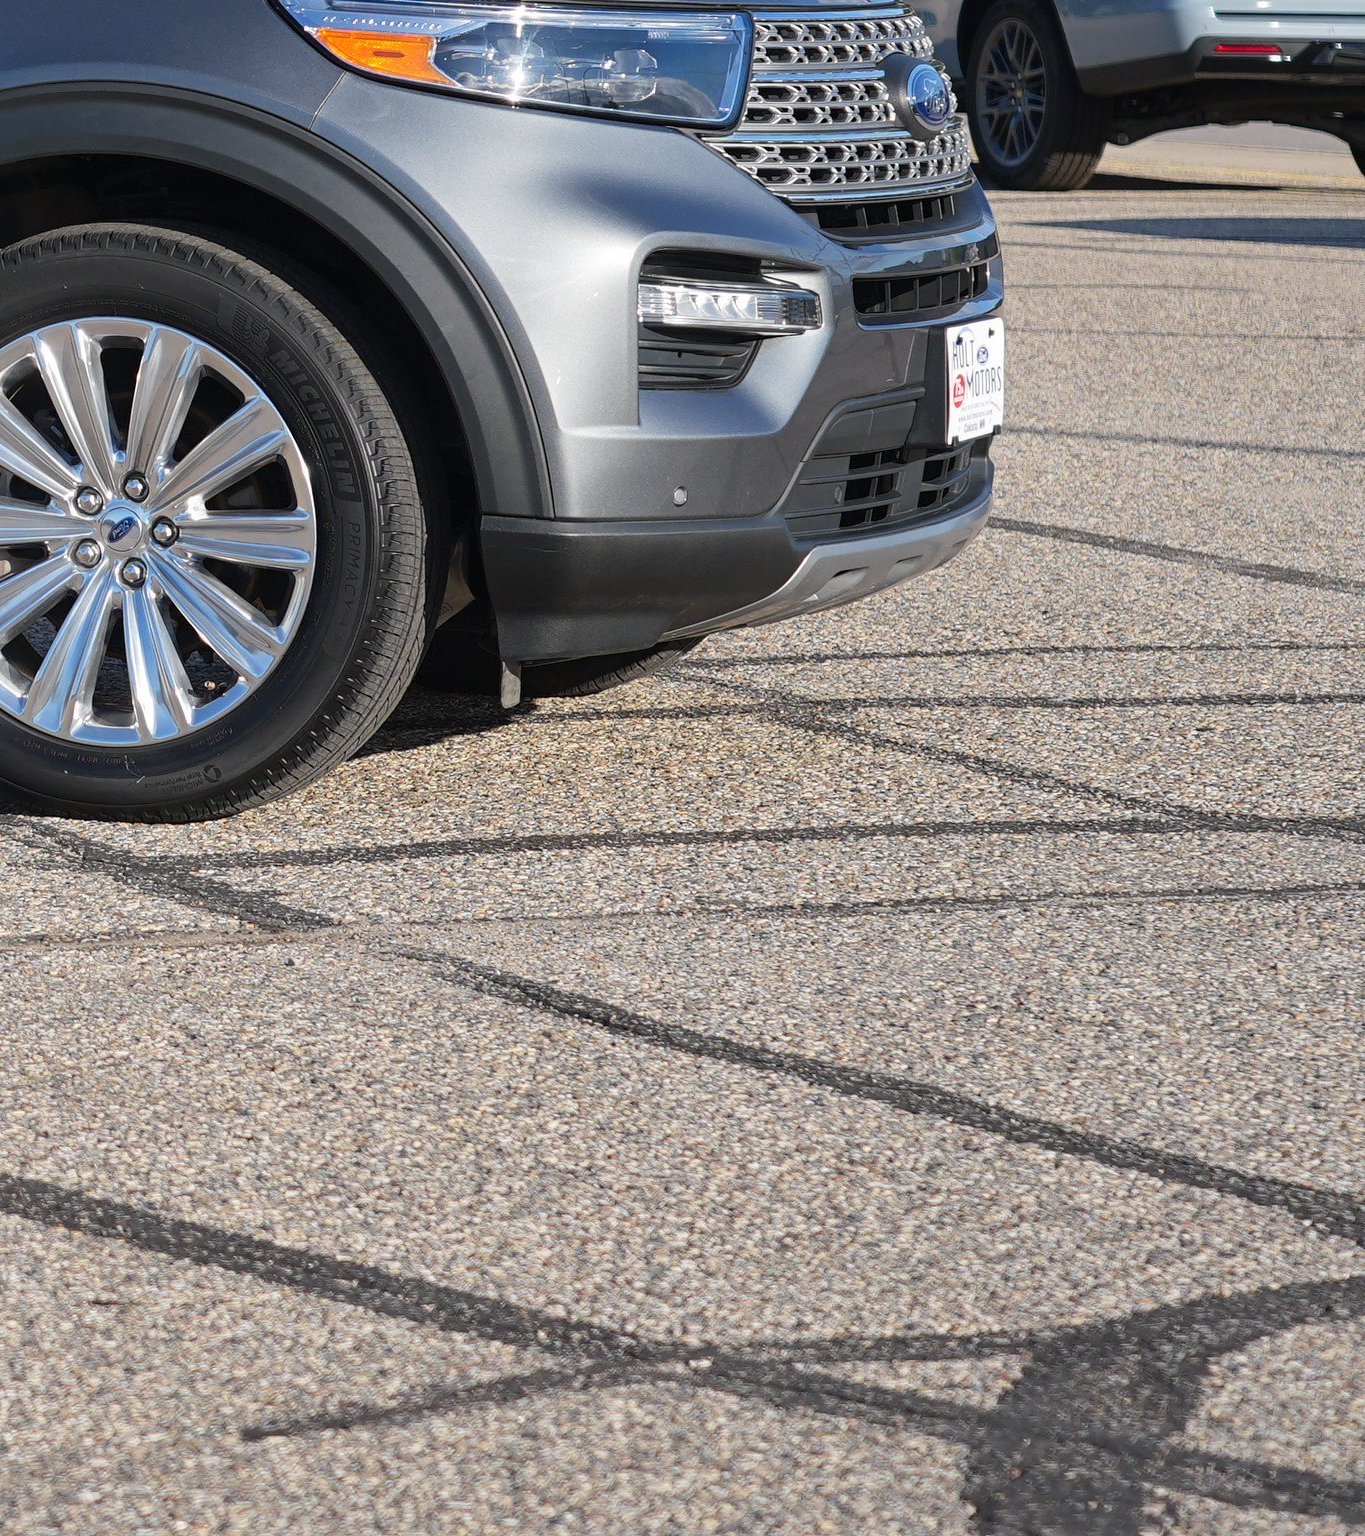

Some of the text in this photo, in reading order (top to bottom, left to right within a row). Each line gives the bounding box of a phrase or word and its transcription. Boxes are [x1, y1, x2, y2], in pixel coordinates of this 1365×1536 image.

[952, 340, 975, 370] HOLT
[966, 366, 1002, 399] MOTORS
[269, 348, 357, 495] MICHELIN
[343, 520, 361, 611] PRIMACY
